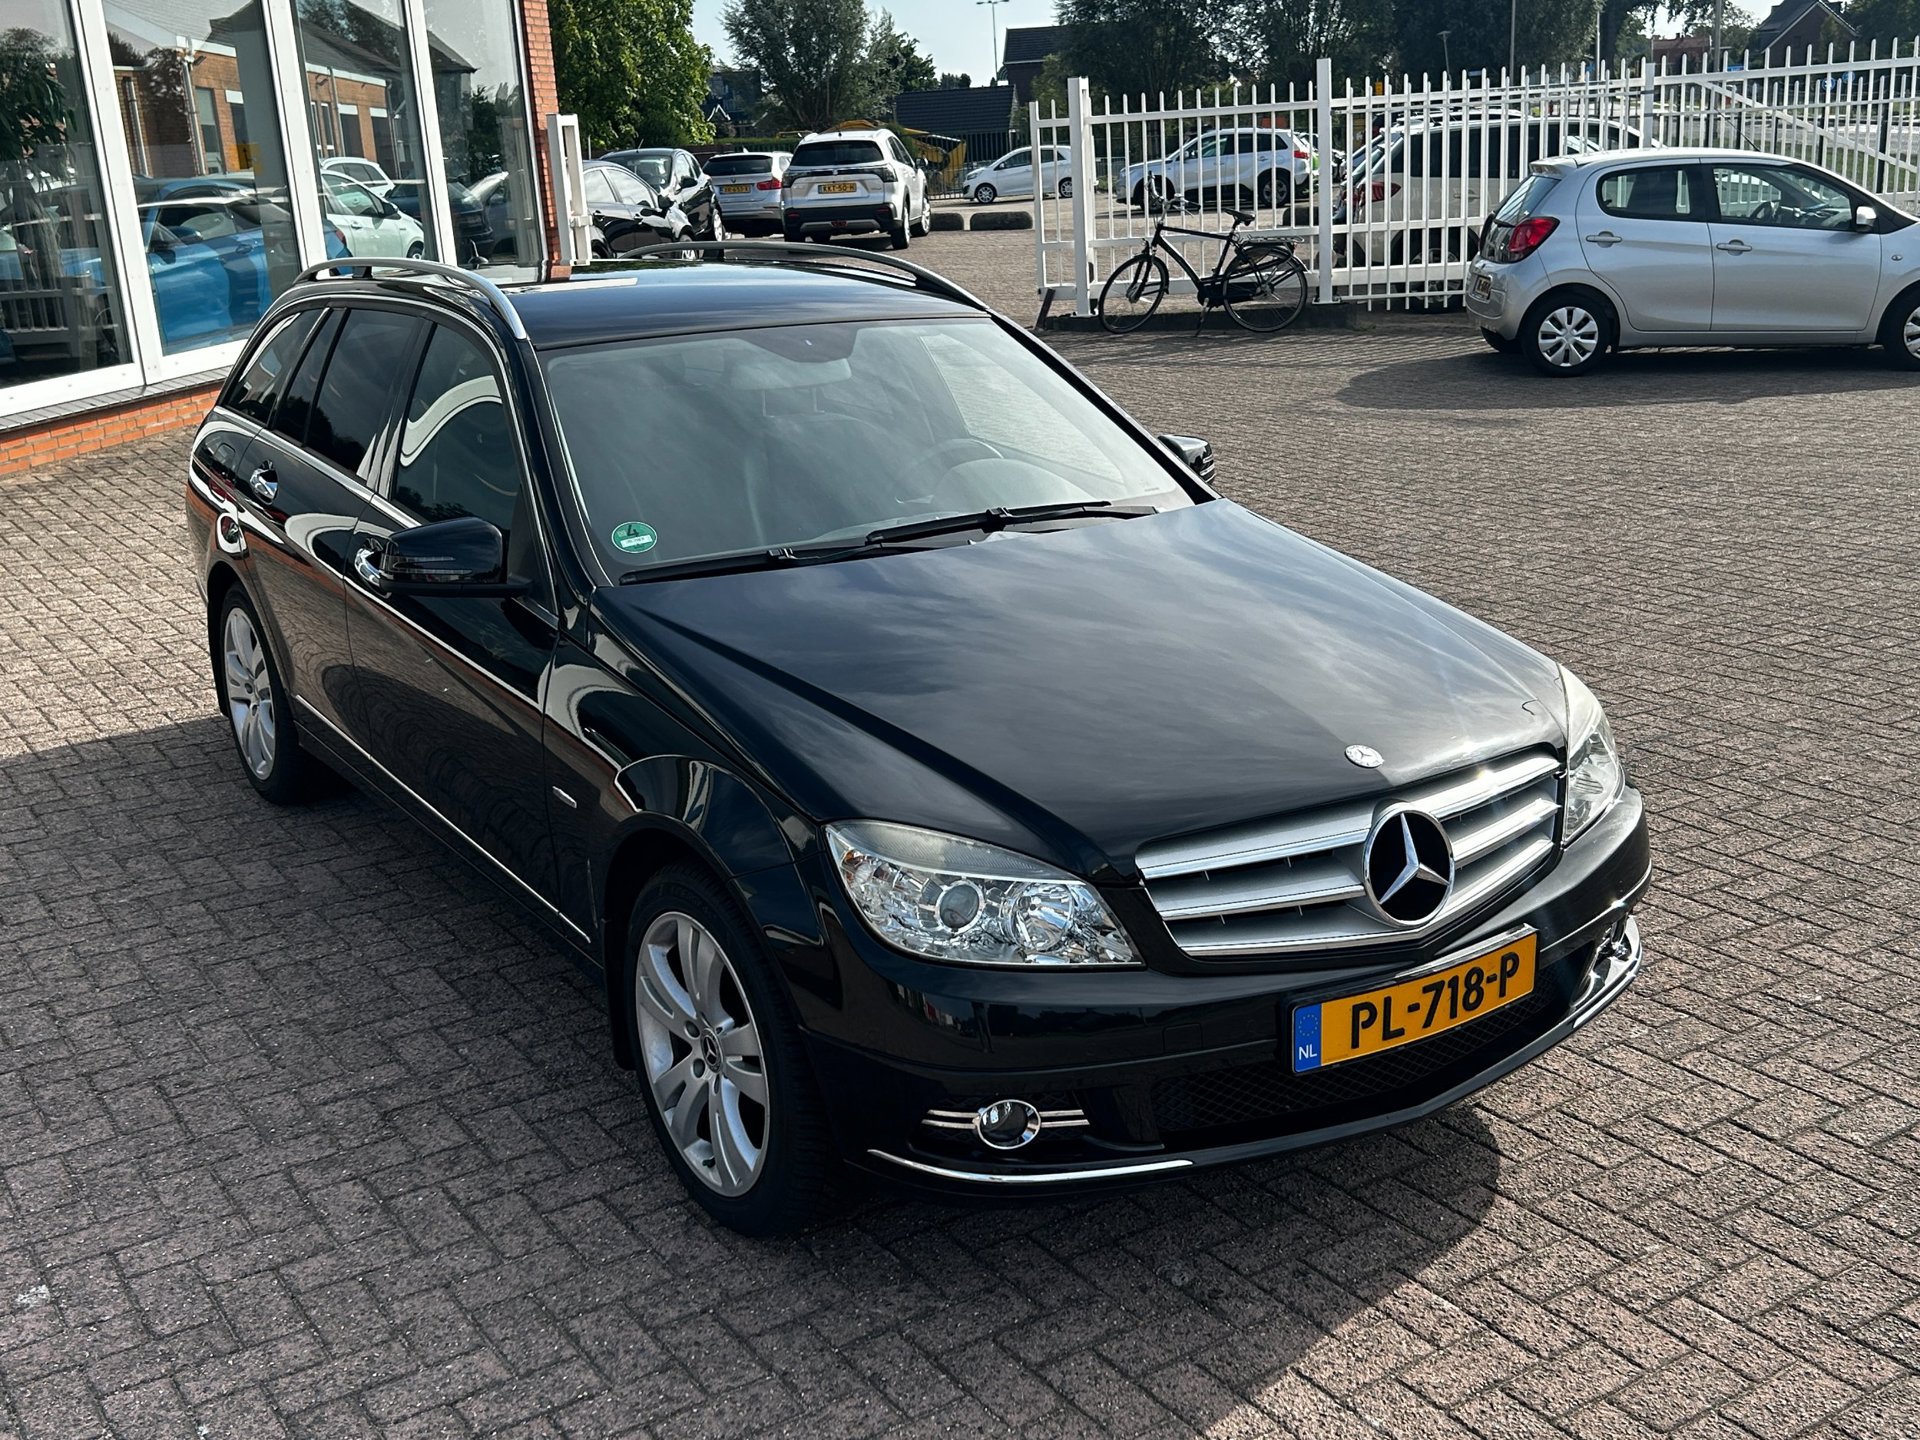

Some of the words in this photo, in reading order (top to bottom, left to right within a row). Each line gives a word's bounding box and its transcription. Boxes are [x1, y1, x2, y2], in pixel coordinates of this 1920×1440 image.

[627, 524, 639, 537] 4
[1351, 952, 1520, 1049] PL-718-P
[1298, 1044, 1317, 1060] NL
